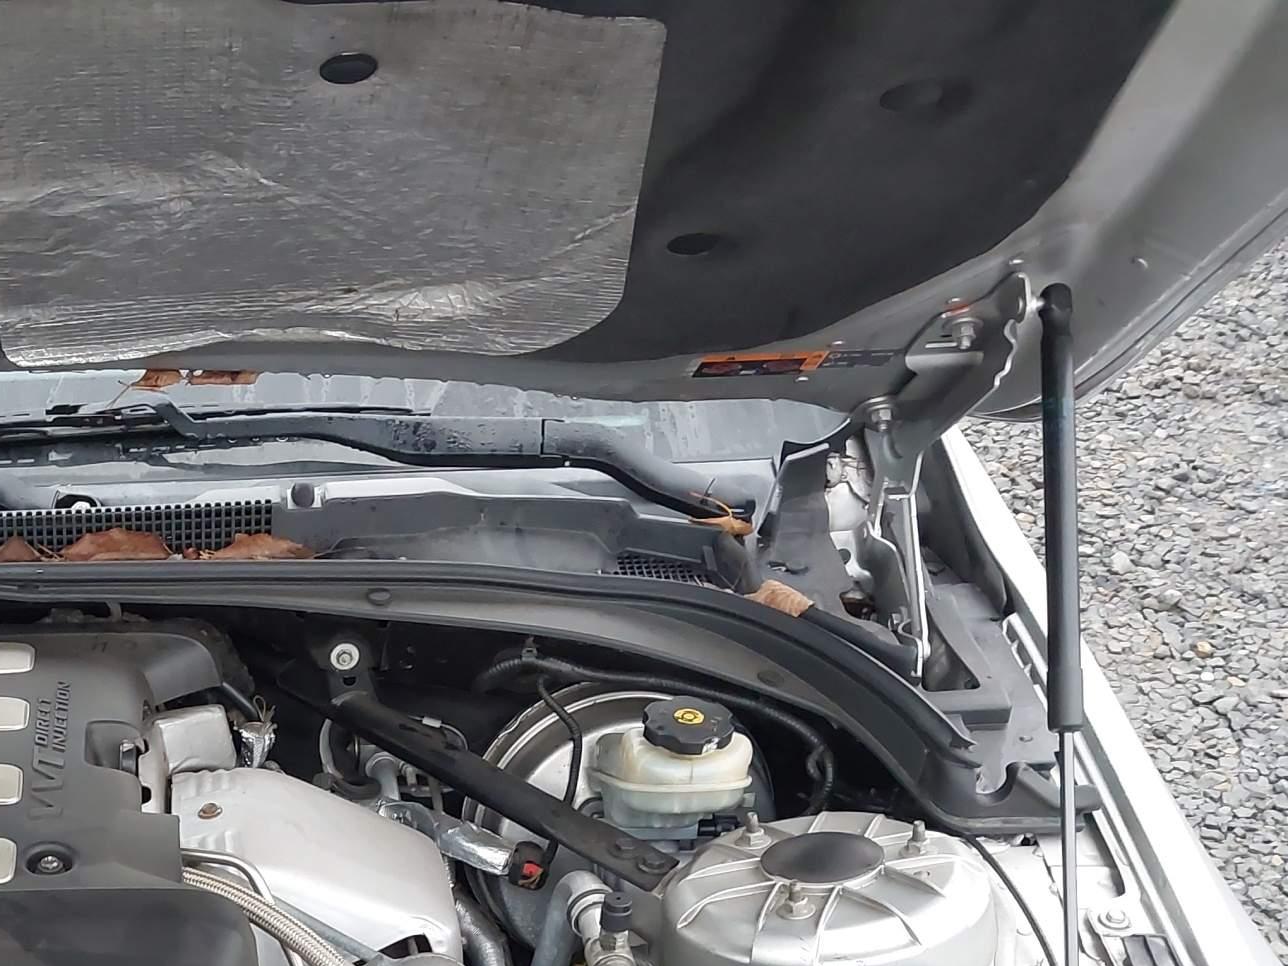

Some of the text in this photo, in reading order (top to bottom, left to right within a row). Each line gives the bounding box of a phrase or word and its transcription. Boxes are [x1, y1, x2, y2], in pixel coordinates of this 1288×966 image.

[33, 698, 52, 747] DIRECT
[52, 681, 71, 752] INJECTION
[29, 747, 65, 819] VVT
